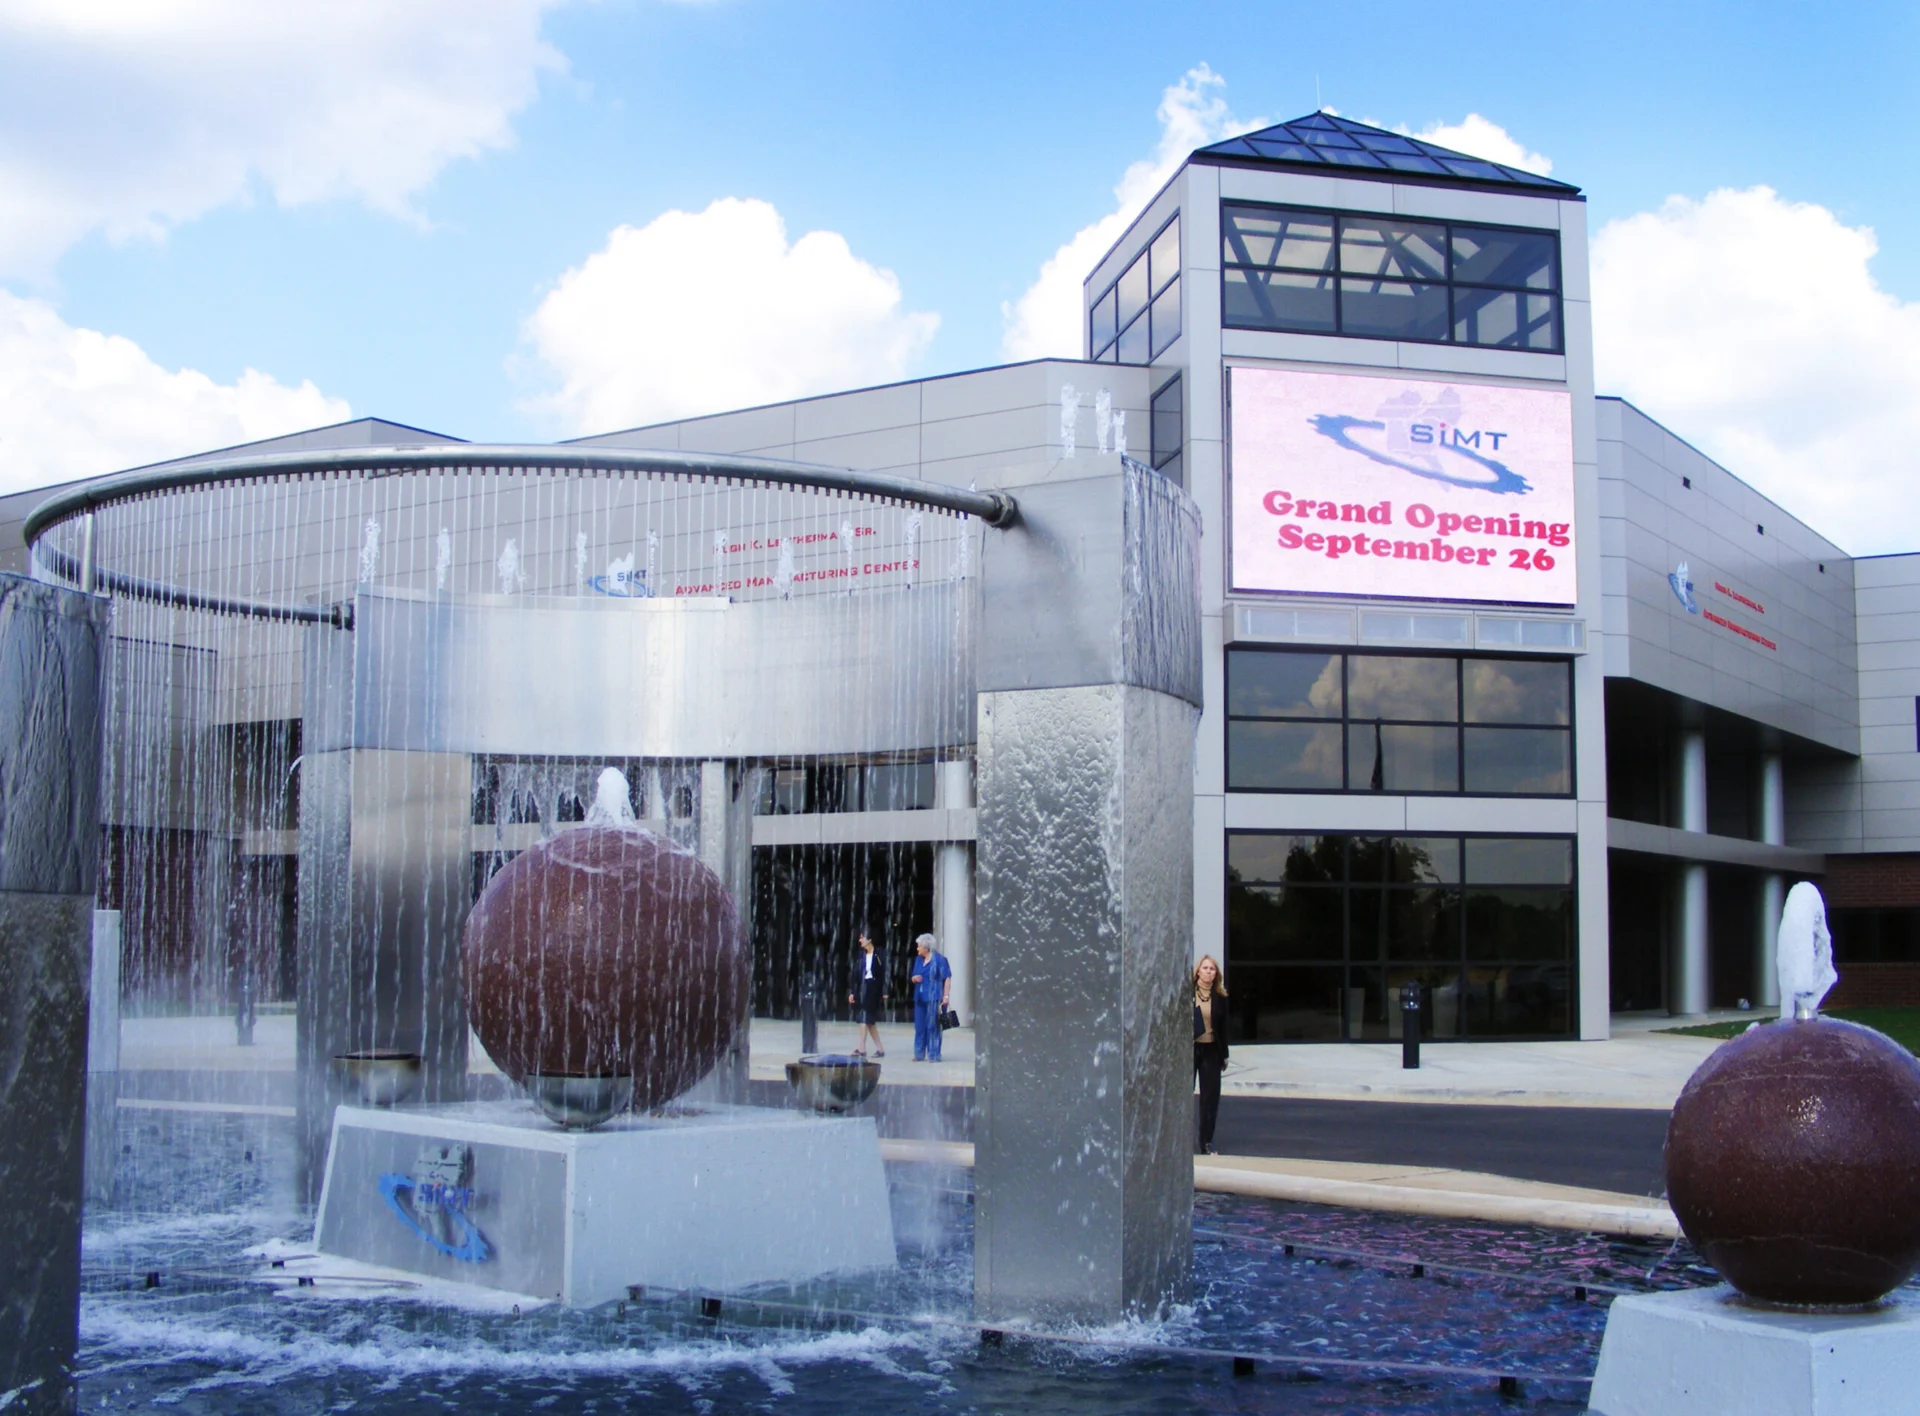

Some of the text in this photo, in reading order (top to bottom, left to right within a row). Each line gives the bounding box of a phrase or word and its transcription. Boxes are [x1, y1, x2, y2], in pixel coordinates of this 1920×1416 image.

[1410, 422, 1507, 451] SiMT
[1262, 490, 1571, 546] Grand Opening
[1278, 524, 1556, 571] September 26
